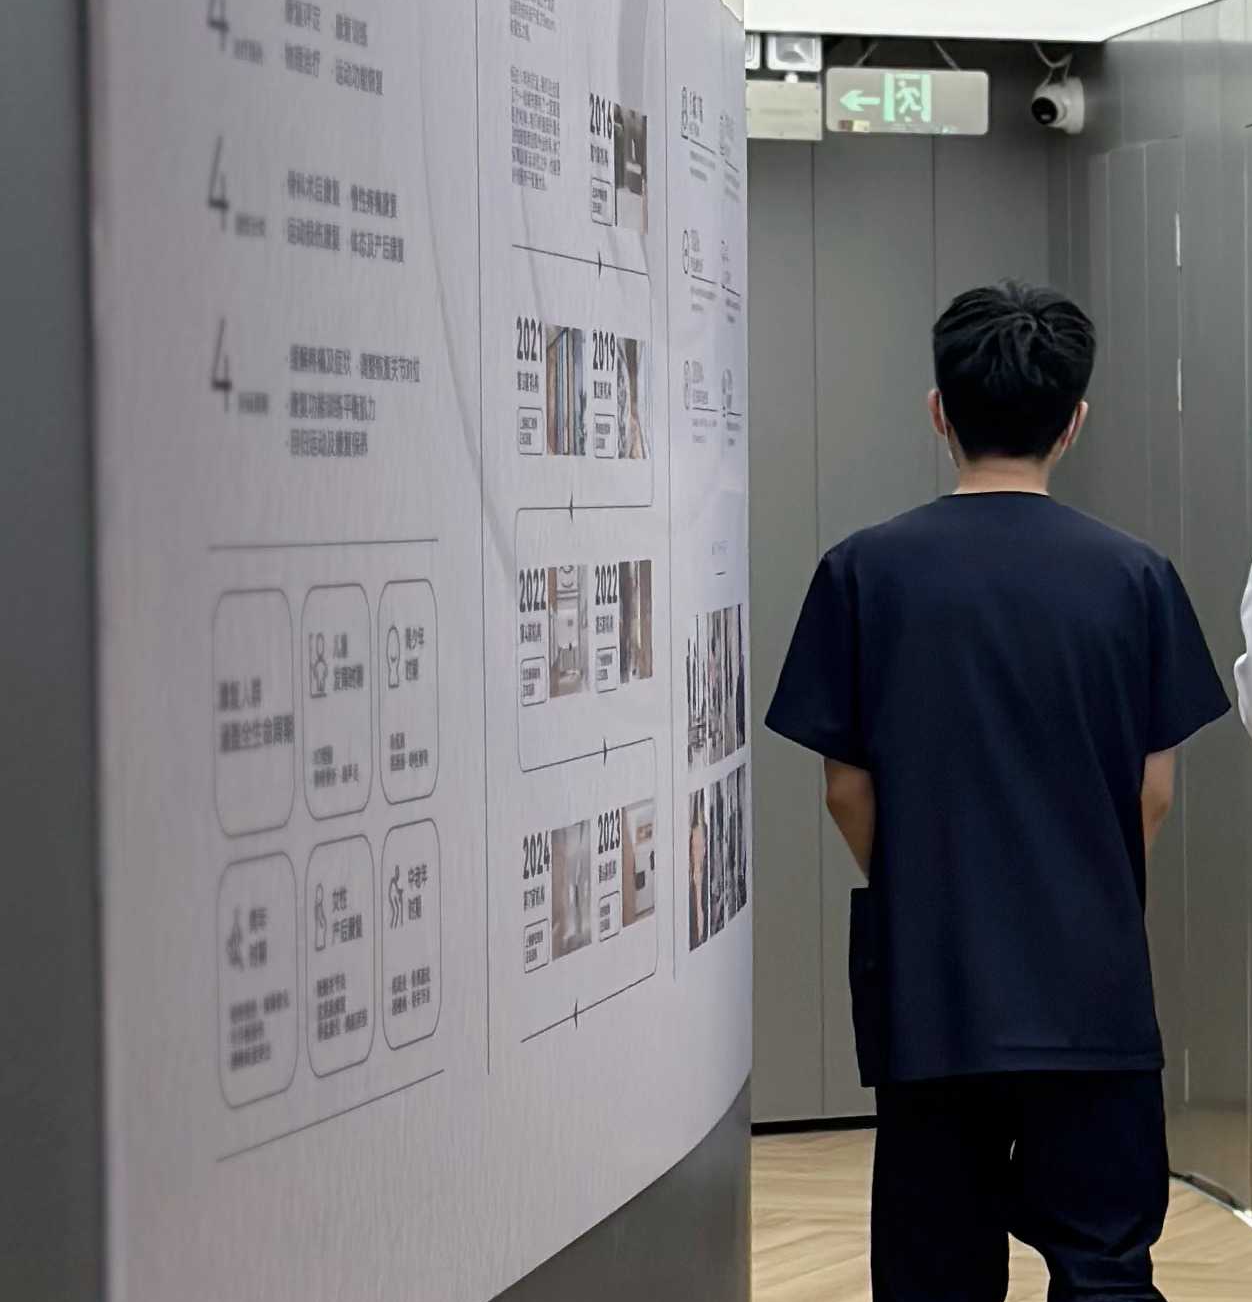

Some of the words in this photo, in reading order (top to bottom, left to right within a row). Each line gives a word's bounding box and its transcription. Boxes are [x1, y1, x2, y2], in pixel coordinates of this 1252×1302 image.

[589, 92, 613, 140] 2016
[207, 135, 230, 233] 4
[210, 314, 232, 412] 4
[516, 315, 543, 363] 2021
[592, 329, 616, 372] 2019
[519, 567, 547, 613] 2022
[595, 563, 619, 606] 2022
[522, 829, 551, 880] 2024
[598, 808, 621, 855] 2023
